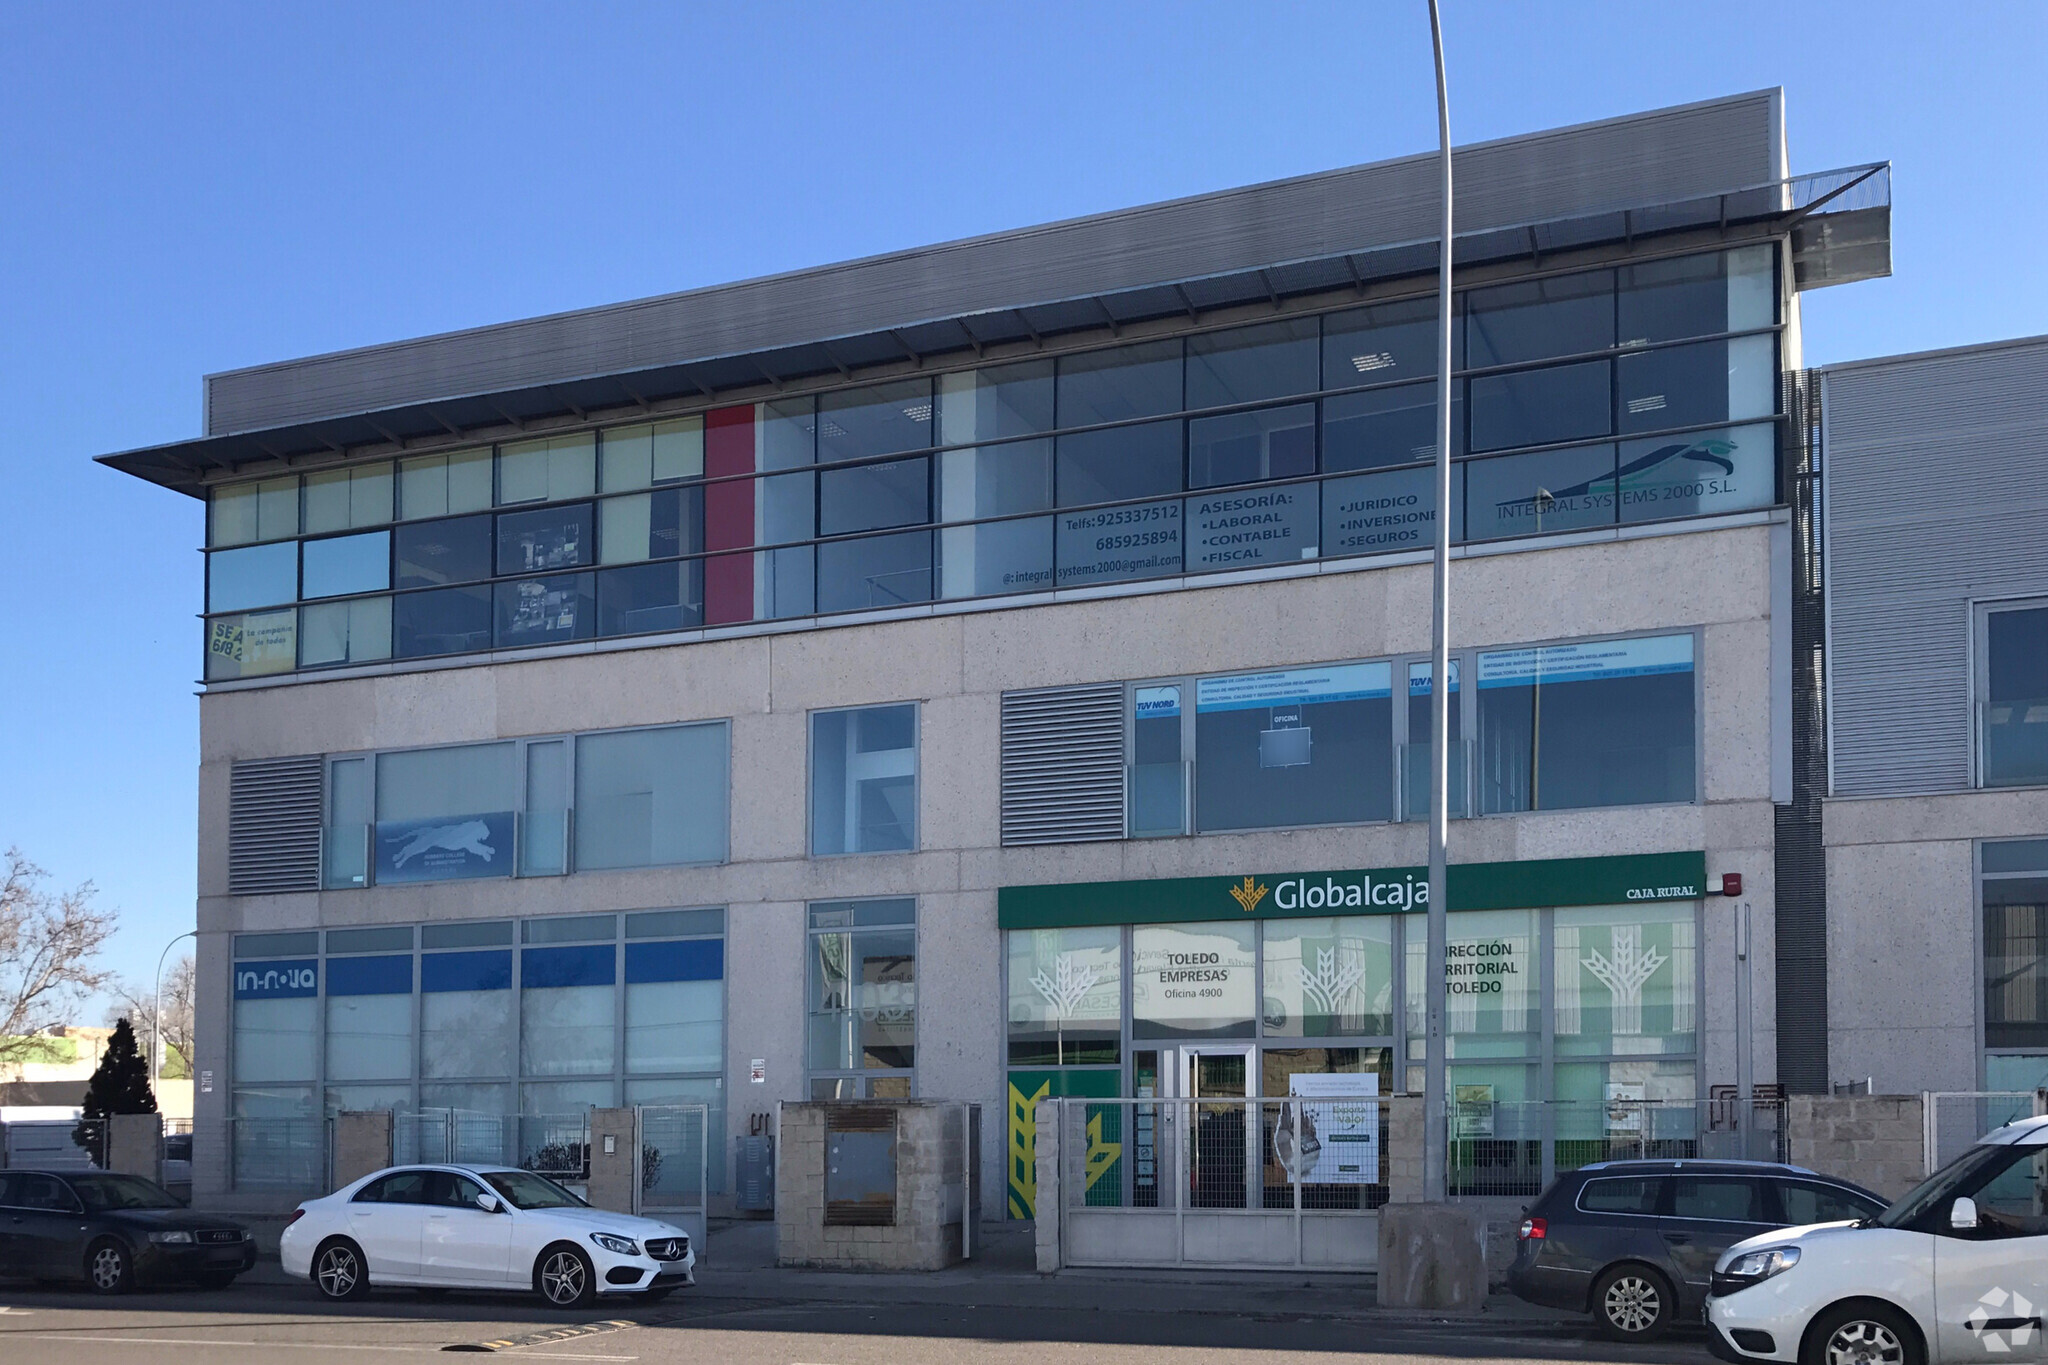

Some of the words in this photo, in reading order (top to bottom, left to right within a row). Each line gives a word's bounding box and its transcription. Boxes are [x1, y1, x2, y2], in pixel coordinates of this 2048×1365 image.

[1200, 492, 1293, 515] ASESORÍA:
[1347, 495, 1418, 513] JURIDICO
[1498, 498, 1578, 520] INTEGRAL
[1583, 488, 1658, 510] SYSEMS
[1663, 483, 1704, 500] 2000
[1709, 480, 1737, 494] S.L.
[1097, 505, 1178, 527] 925337512
[1210, 513, 1283, 530] LABORAL
[1347, 510, 1436, 530] INVERSIONE
[1096, 529, 1178, 551] 685925894
[1210, 527, 1291, 546] CONTABLE
[1347, 529, 1418, 547] SEGUROS
[1210, 548, 1263, 563] FISCAL
[1152, 700, 1174, 709] NORD
[1274, 714, 1298, 723] OFICINA
[1274, 875, 1429, 911] Globalcaja
[1626, 889, 1655, 899] CAJA
[1657, 886, 1697, 897] RURAL
[1445, 940, 1512, 957] IRECCIÓN
[1167, 952, 1219, 965] TOLEDO
[1160, 970, 1229, 983] EMPRESAS
[1445, 962, 1518, 975] RRITORIAL
[1165, 989, 1196, 998] Oficina
[1199, 988, 1222, 997] 4900
[1445, 981, 1502, 994] TOLEDO
